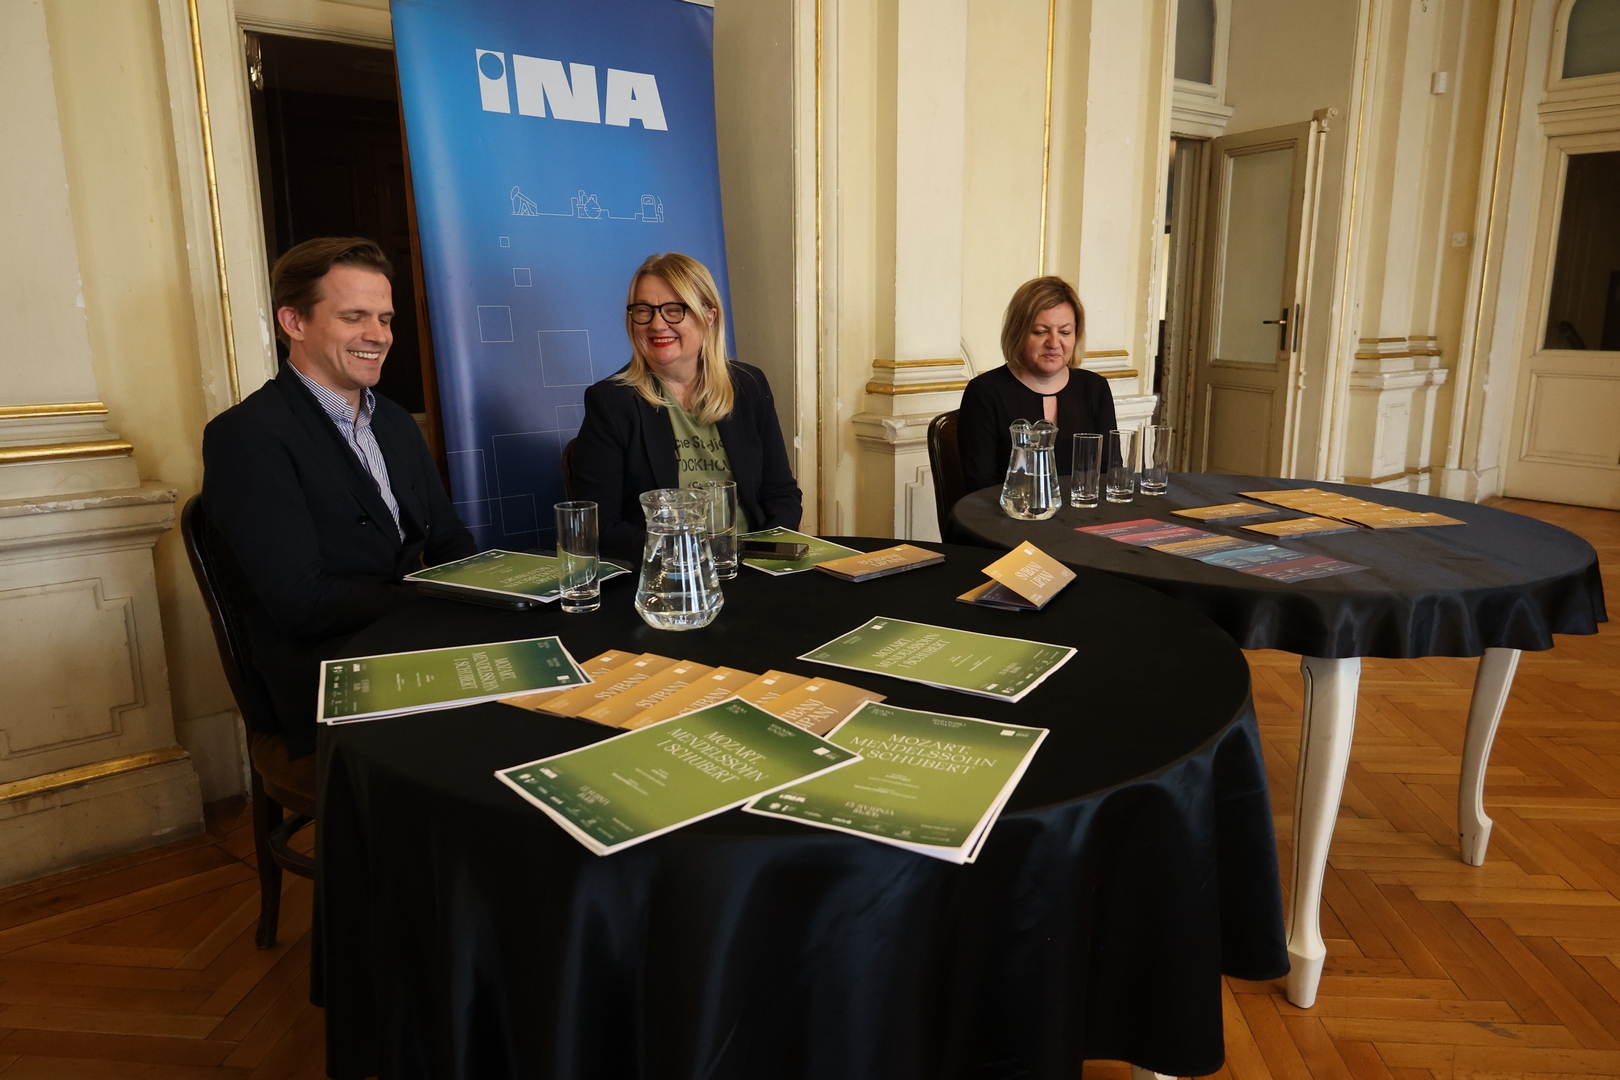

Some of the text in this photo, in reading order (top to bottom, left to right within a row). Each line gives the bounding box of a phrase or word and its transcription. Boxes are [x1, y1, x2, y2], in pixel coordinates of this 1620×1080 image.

[875, 632, 940, 668] MENDELSSOHN
[902, 639, 950, 665] SCHUBERT
[595, 672, 650, 700] SVIBANJ
[636, 680, 689, 708] SVIBANJ
[664, 742, 740, 783] SCHUBERT
[667, 728, 770, 782] MENDELSSOHN
[850, 736, 997, 768] MENDELSSOHN
[866, 750, 974, 774] SCHUBERT
